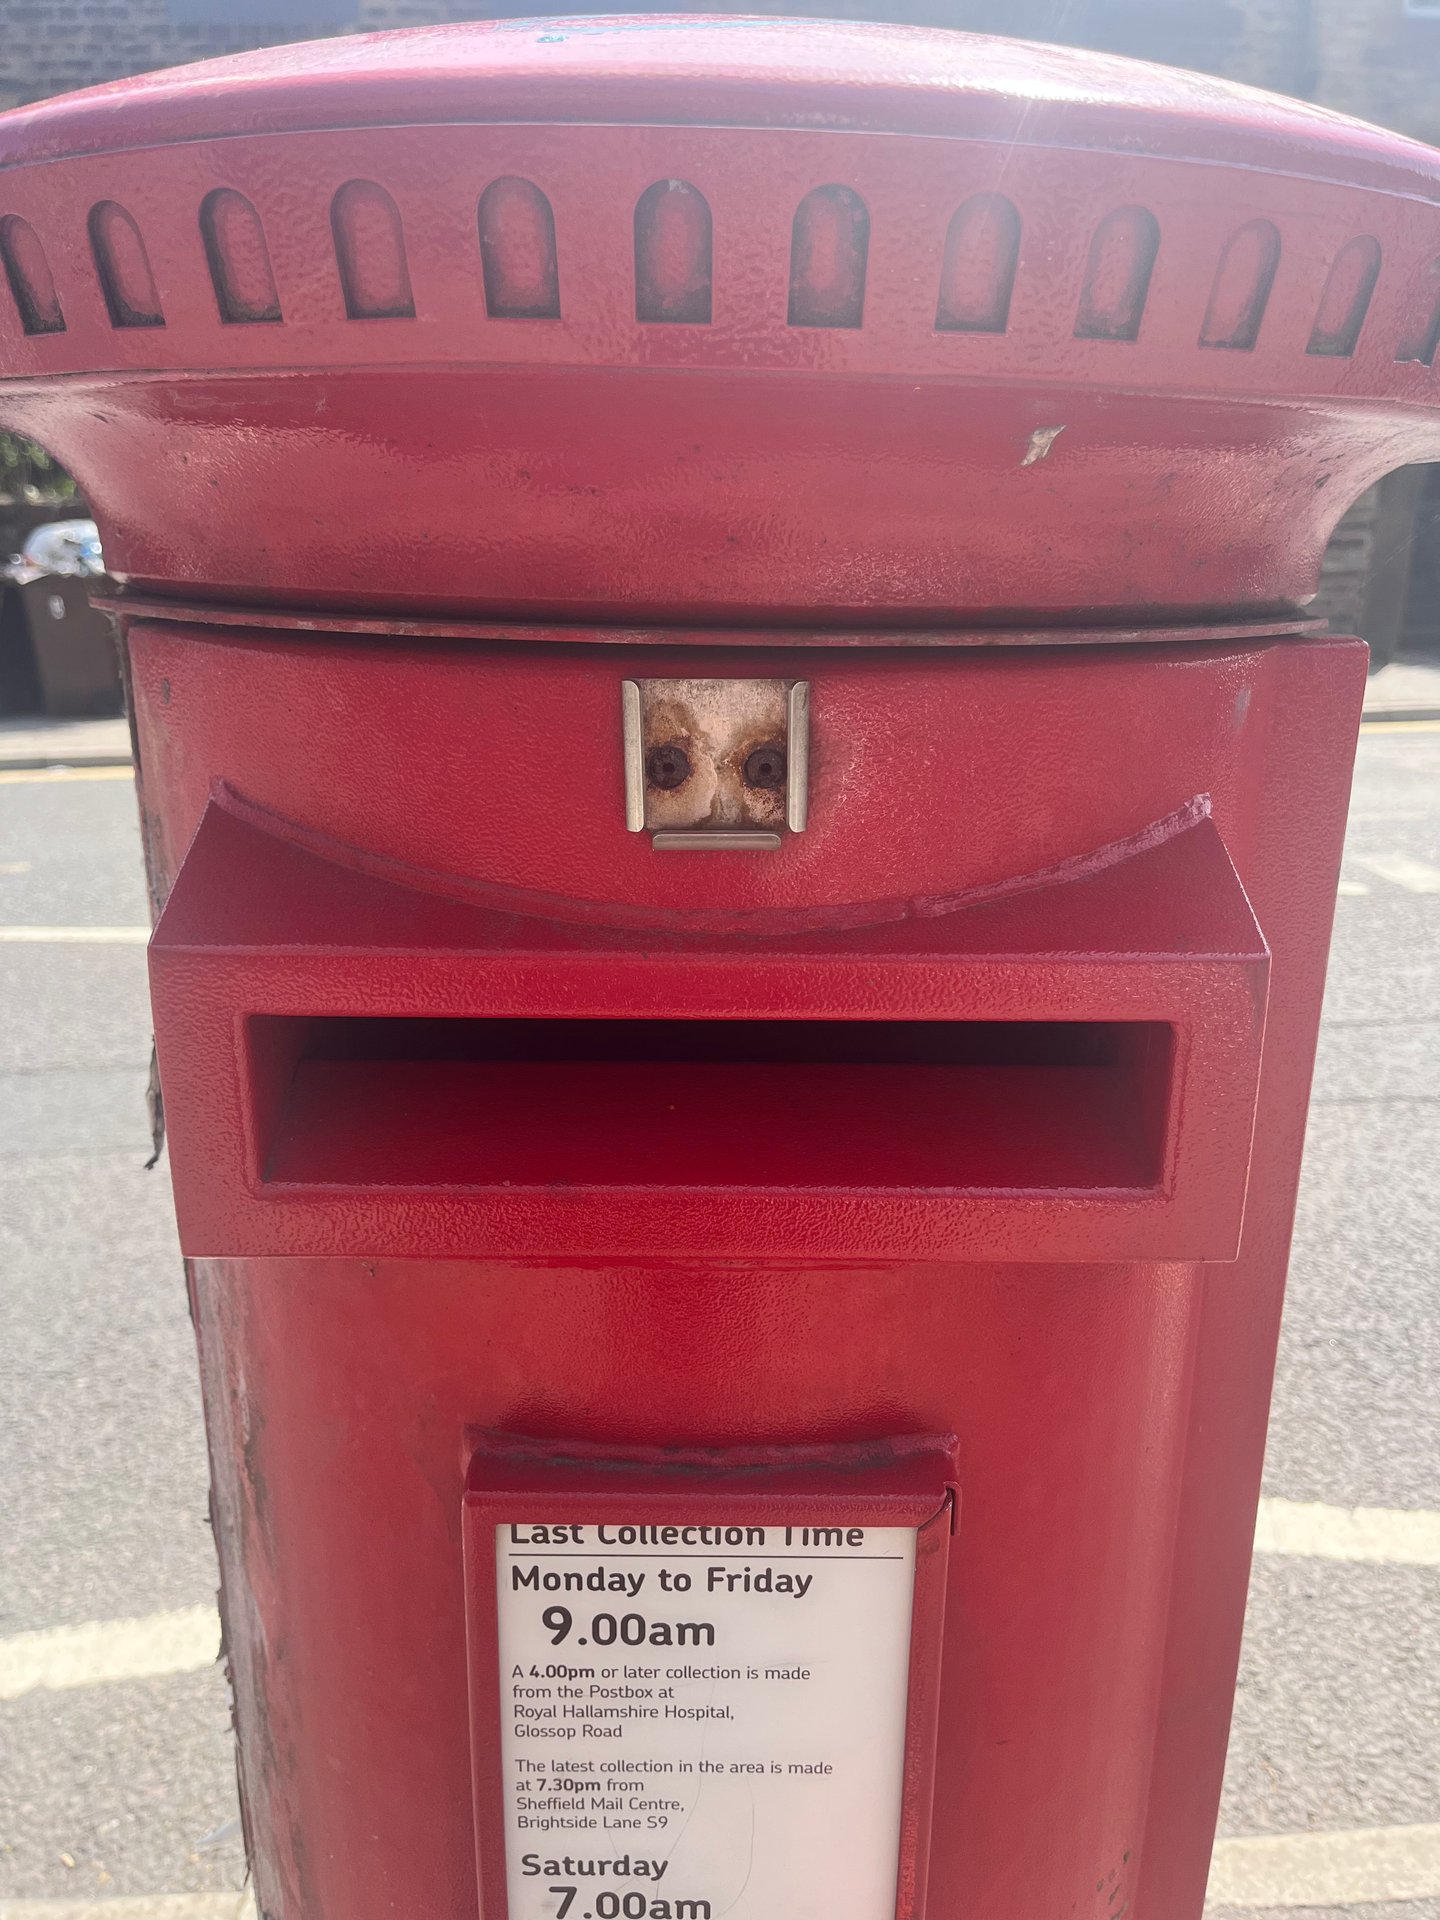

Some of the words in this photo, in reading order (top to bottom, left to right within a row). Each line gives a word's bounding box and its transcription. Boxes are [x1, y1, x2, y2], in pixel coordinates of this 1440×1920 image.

[510, 1525, 584, 1544] Last
[598, 1525, 765, 1545] Collection
[511, 1564, 646, 1598] Monday
[657, 1568, 692, 1593] to
[707, 1566, 813, 1599] Friday
[541, 1605, 715, 1647] 9.00am
[511, 1664, 524, 1679] A
[528, 1664, 595, 1682] 4.00pm
[601, 1668, 619, 1679] or
[623, 1664, 661, 1679] later
[665, 1665, 741, 1680] collection
[746, 1665, 759, 1680] is
[764, 1666, 811, 1680] made
[512, 1684, 552, 1699] from
[557, 1684, 584, 1699] the
[589, 1684, 653, 1699] Postbox
[658, 1686, 675, 1699] at
[513, 1704, 557, 1721] Royal
[563, 1704, 659, 1719] Hallamshire
[664, 1704, 734, 1722] Hospital,
[514, 1723, 577, 1741] Glossop
[582, 1723, 623, 1738] Road
[514, 1758, 546, 1773] The
[551, 1759, 595, 1773] latest
[599, 1759, 673, 1773] collection
[679, 1759, 693, 1773] in
[698, 1759, 725, 1774] the
[729, 1763, 765, 1774] area
[770, 1760, 783, 1774] is
[788, 1761, 833, 1775] made
[515, 1779, 532, 1792] at
[536, 1777, 601, 1795] 7.30pm
[606, 1777, 644, 1792] from
[516, 1796, 585, 1811] Sheffield
[591, 1796, 623, 1811] Mail
[628, 1796, 686, 1814] Centre,
[517, 1815, 598, 1832] Brightside
[603, 1815, 642, 1829] Lane
[646, 1815, 668, 1829] S9
[521, 1853, 669, 1882] Saturday
[548, 1886, 711, 1920] 7.00am
